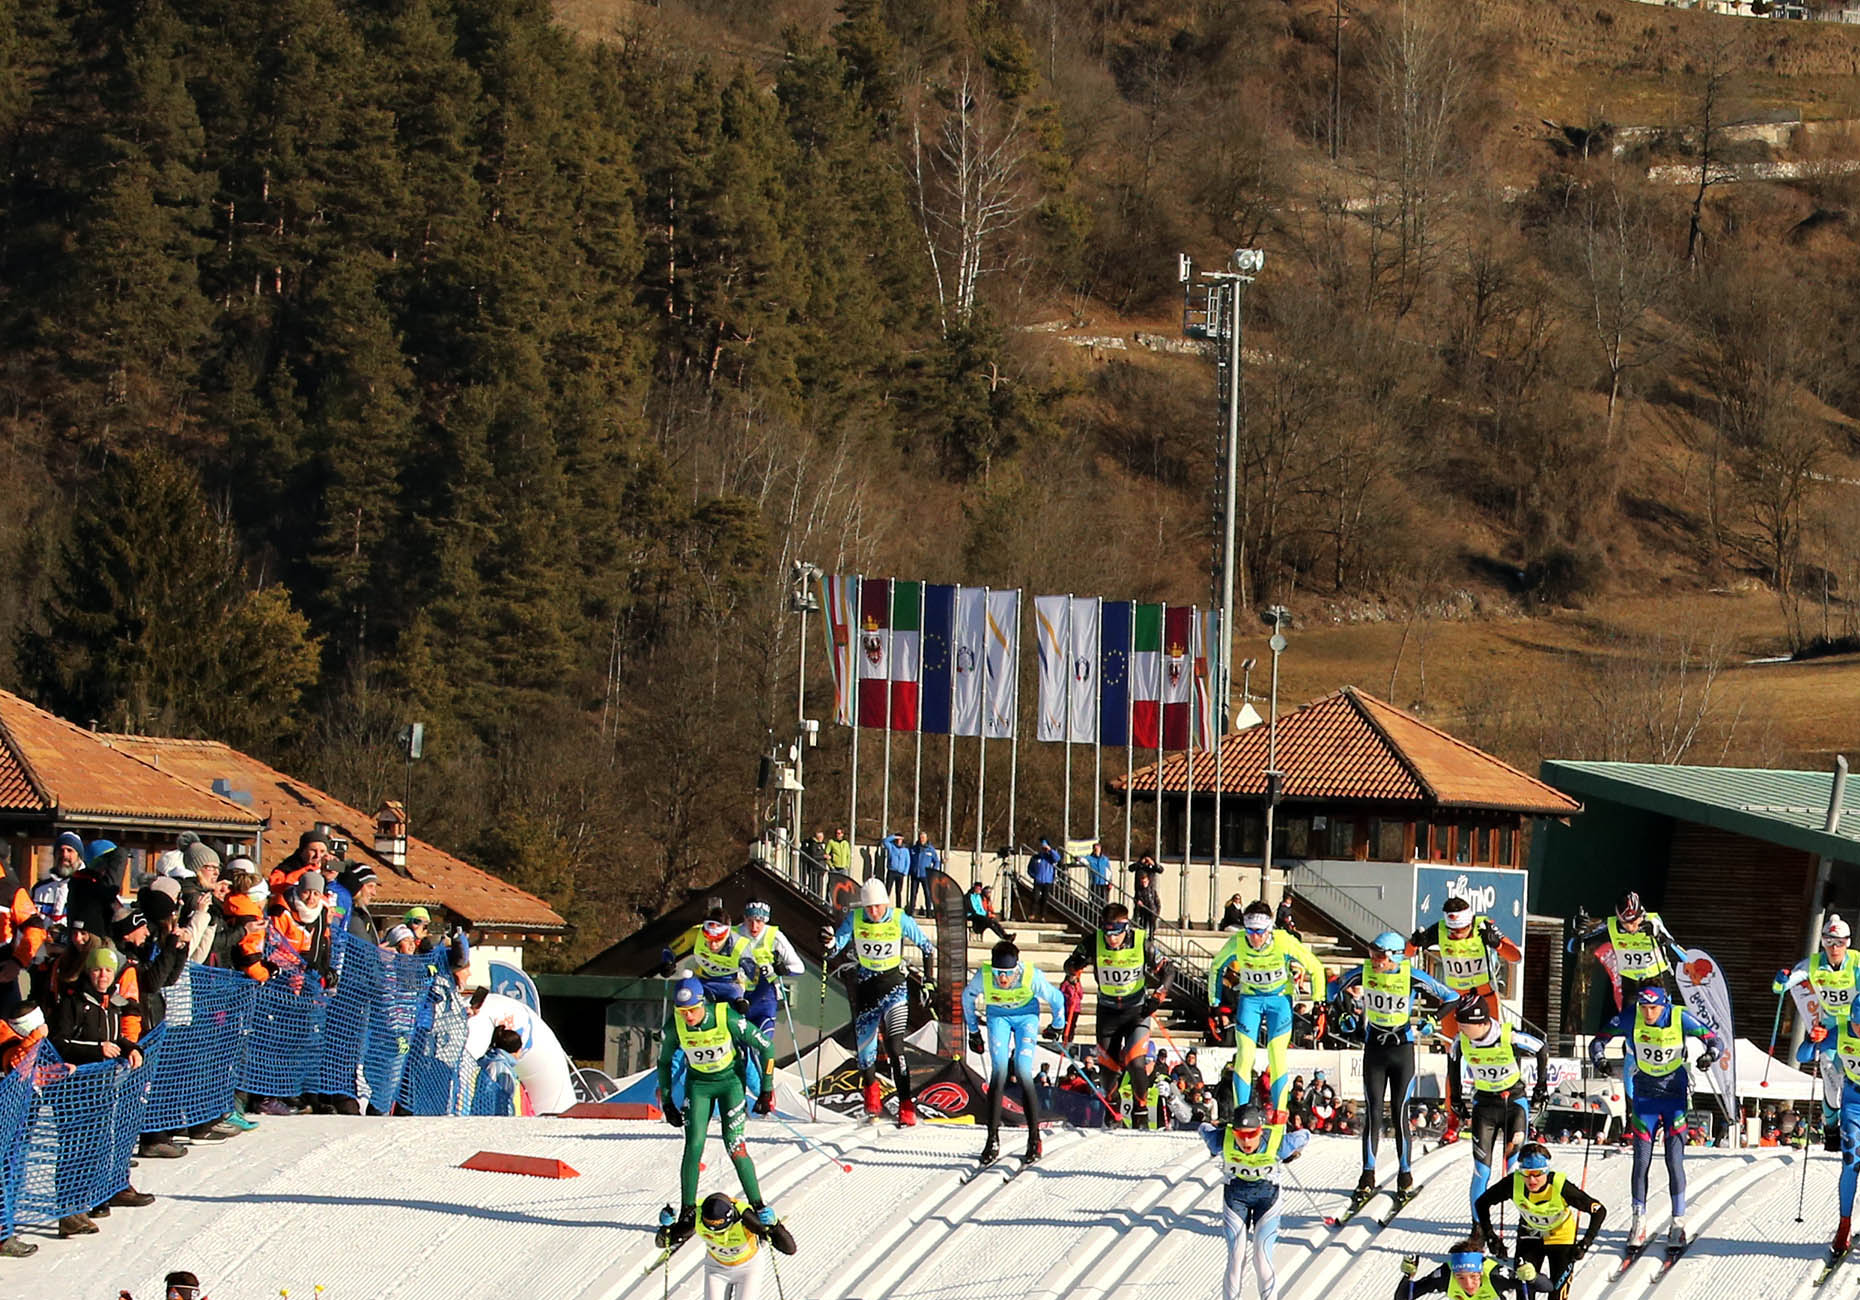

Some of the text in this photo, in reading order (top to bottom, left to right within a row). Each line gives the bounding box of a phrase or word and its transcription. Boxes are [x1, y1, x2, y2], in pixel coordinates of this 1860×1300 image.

[863, 943, 894, 956] 992
[1623, 952, 1653, 965] 993
[1446, 958, 1484, 975] 1017
[1102, 968, 1141, 983] 1025
[1244, 970, 1283, 984] 1015
[1368, 993, 1407, 1010] 1016
[694, 1048, 725, 1062] 991
[1643, 1046, 1673, 1062] 989
